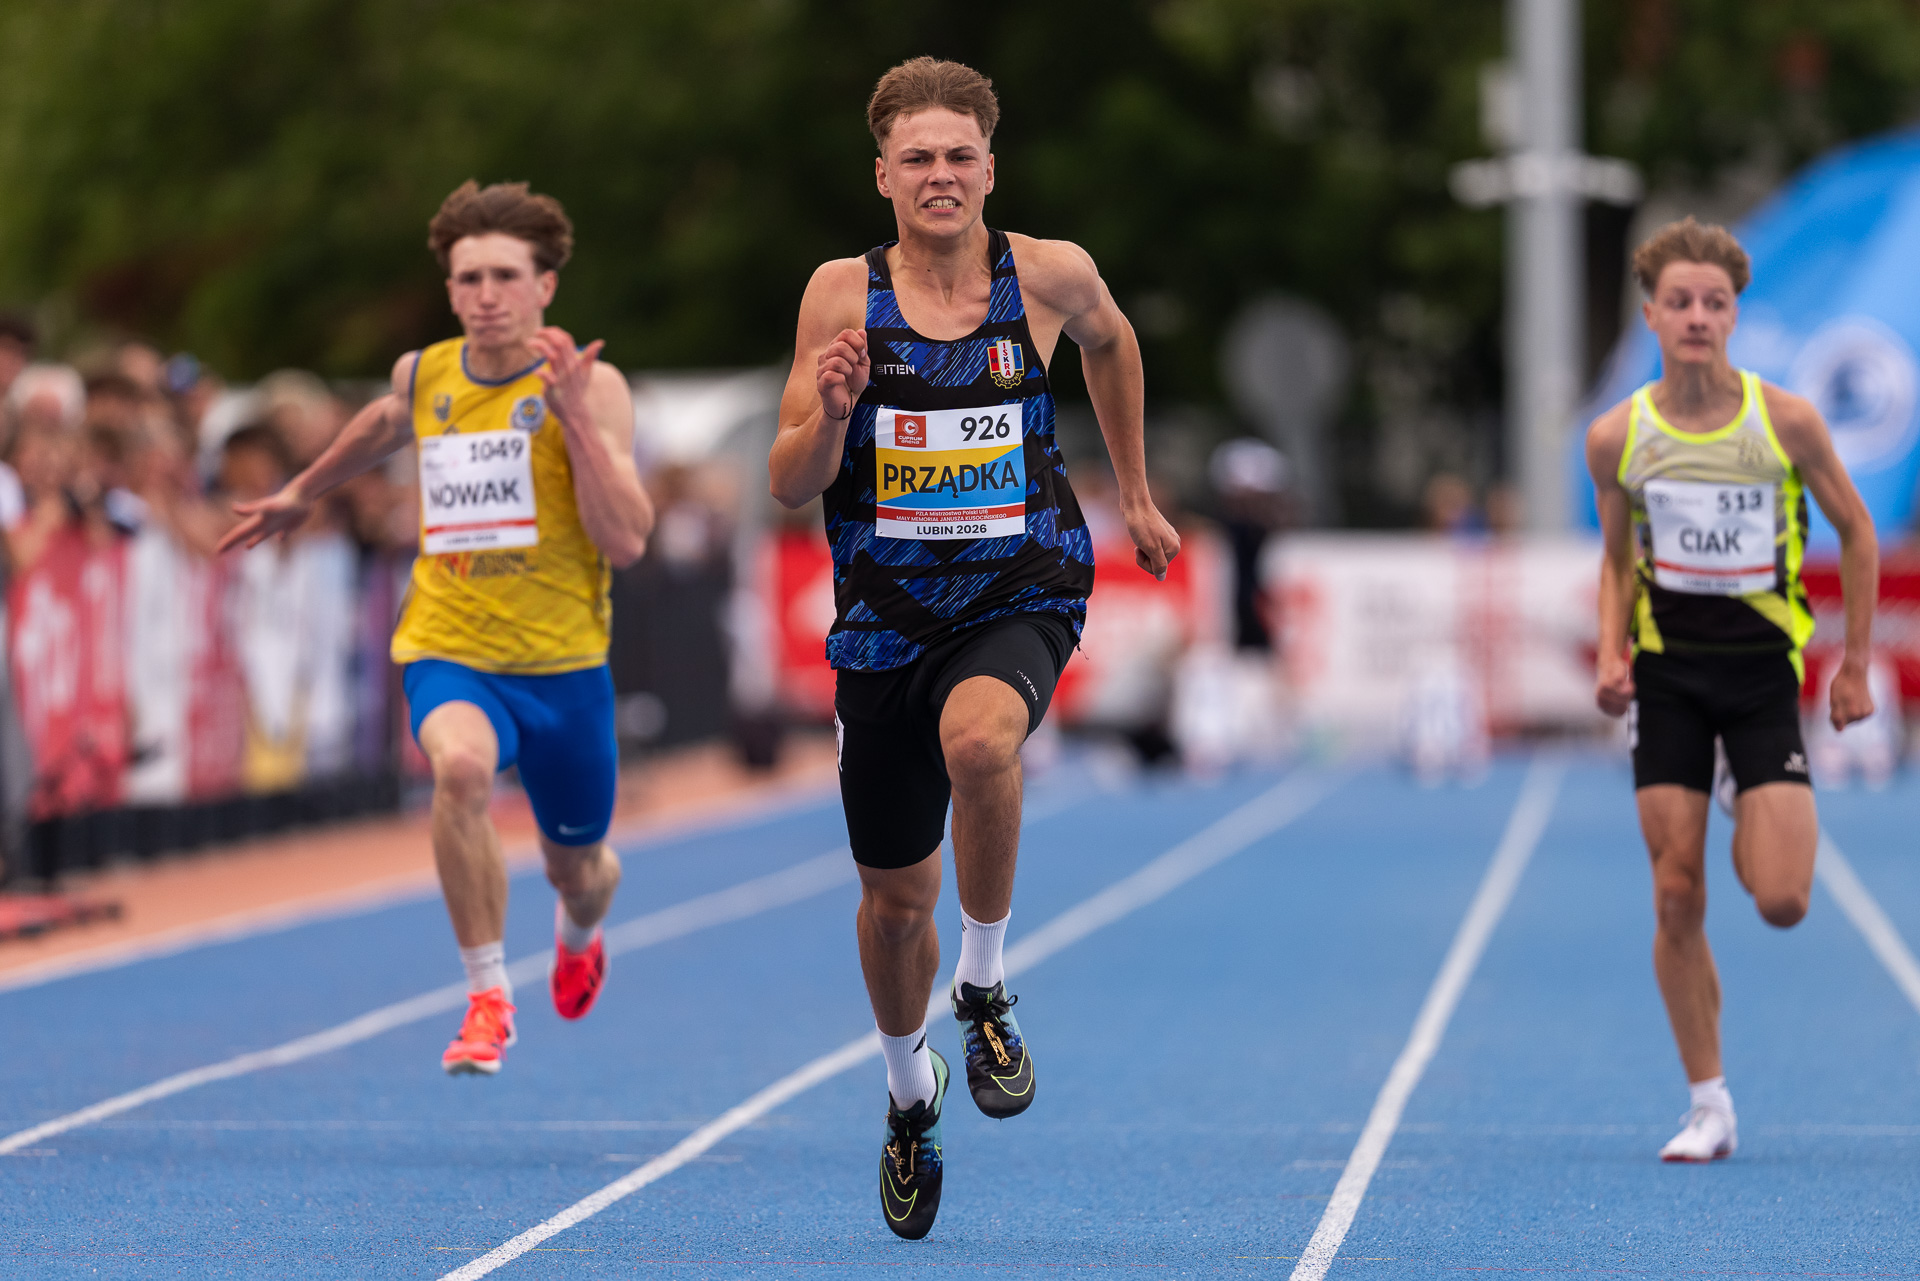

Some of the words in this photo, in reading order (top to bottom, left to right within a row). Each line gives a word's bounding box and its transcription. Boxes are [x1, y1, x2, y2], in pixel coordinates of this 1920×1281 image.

[1002, 342, 1011, 377] ISKRA
[960, 413, 1010, 442] 926
[469, 438, 525, 463] 1049
[428, 478, 521, 509] NOWAK
[883, 460, 1020, 499] PRZĄDKA
[1717, 489, 1763, 514] 513
[916, 525, 954, 535] LUBIN
[956, 524, 988, 534] 2026
[1679, 527, 1742, 556] CIAK
